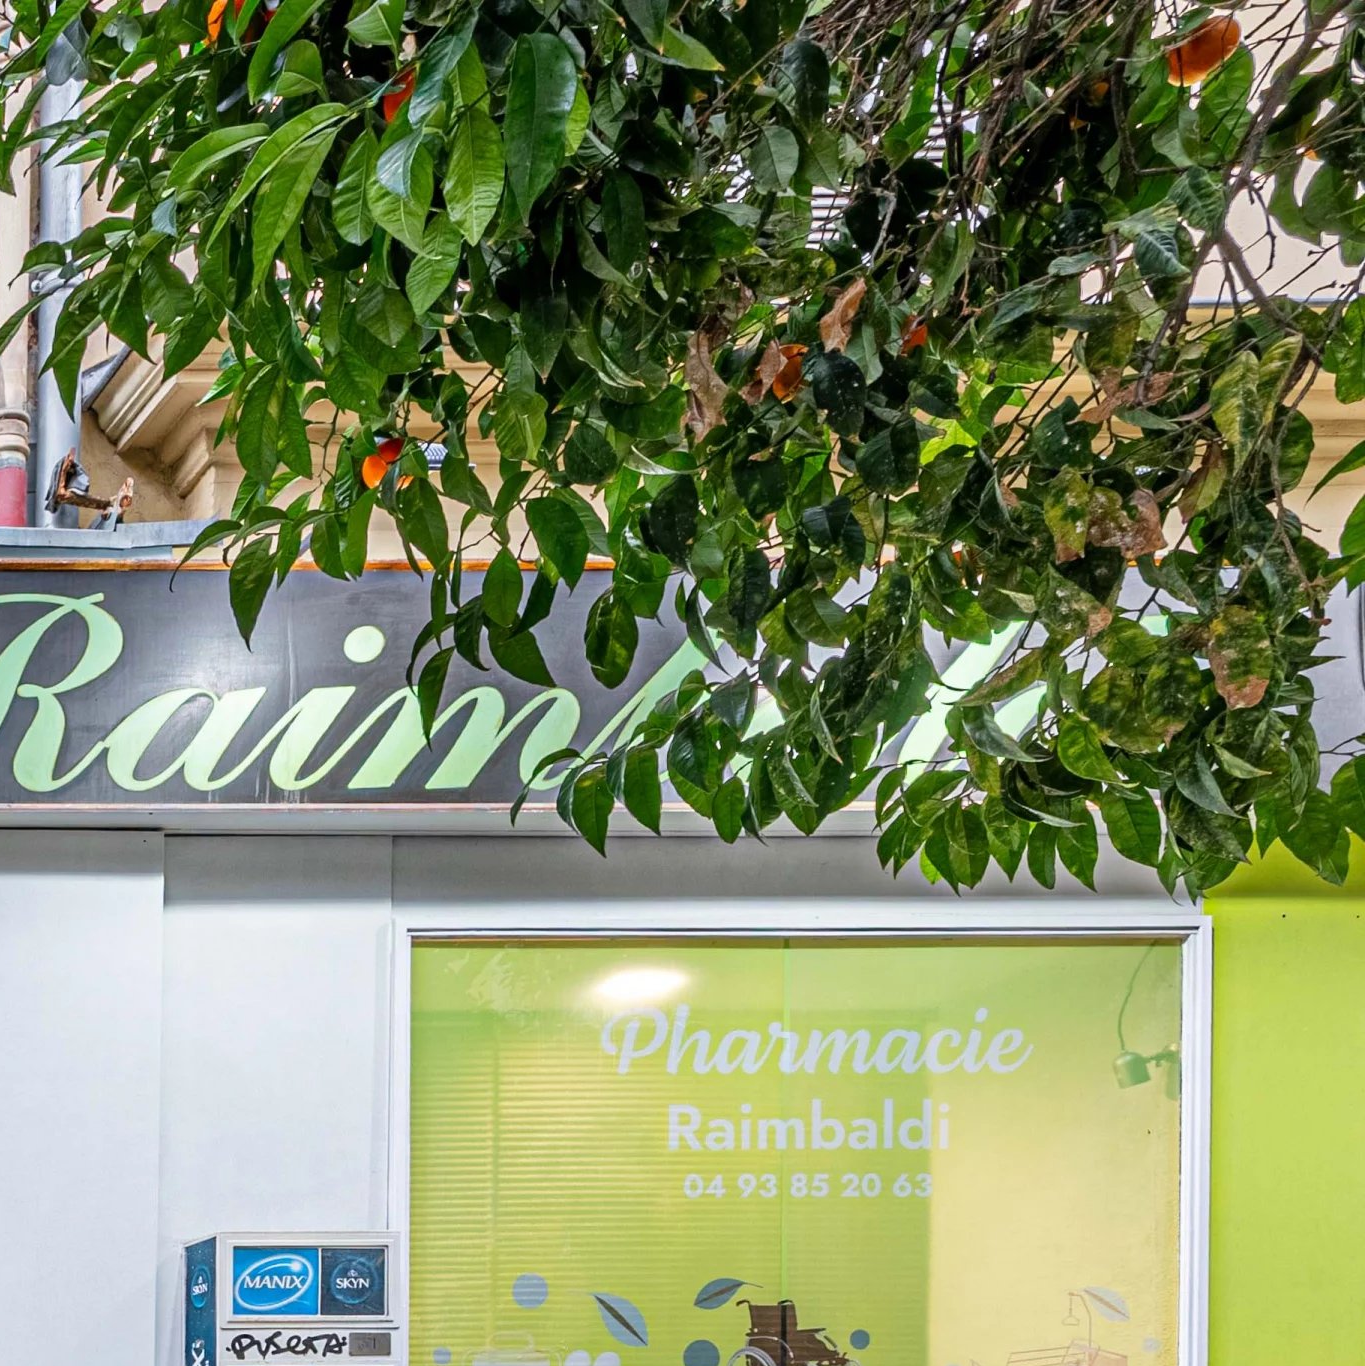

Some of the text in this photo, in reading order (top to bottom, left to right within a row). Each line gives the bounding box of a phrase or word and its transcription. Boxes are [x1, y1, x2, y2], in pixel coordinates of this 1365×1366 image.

[601, 1004, 1034, 1075] Pharmacie
[669, 1098, 950, 1150] Raimbaldi
[683, 1174, 932, 1198] 04 93 85 20 63
[244, 1276, 306, 1289] MANIX
[336, 1278, 369, 1289] SKYN
